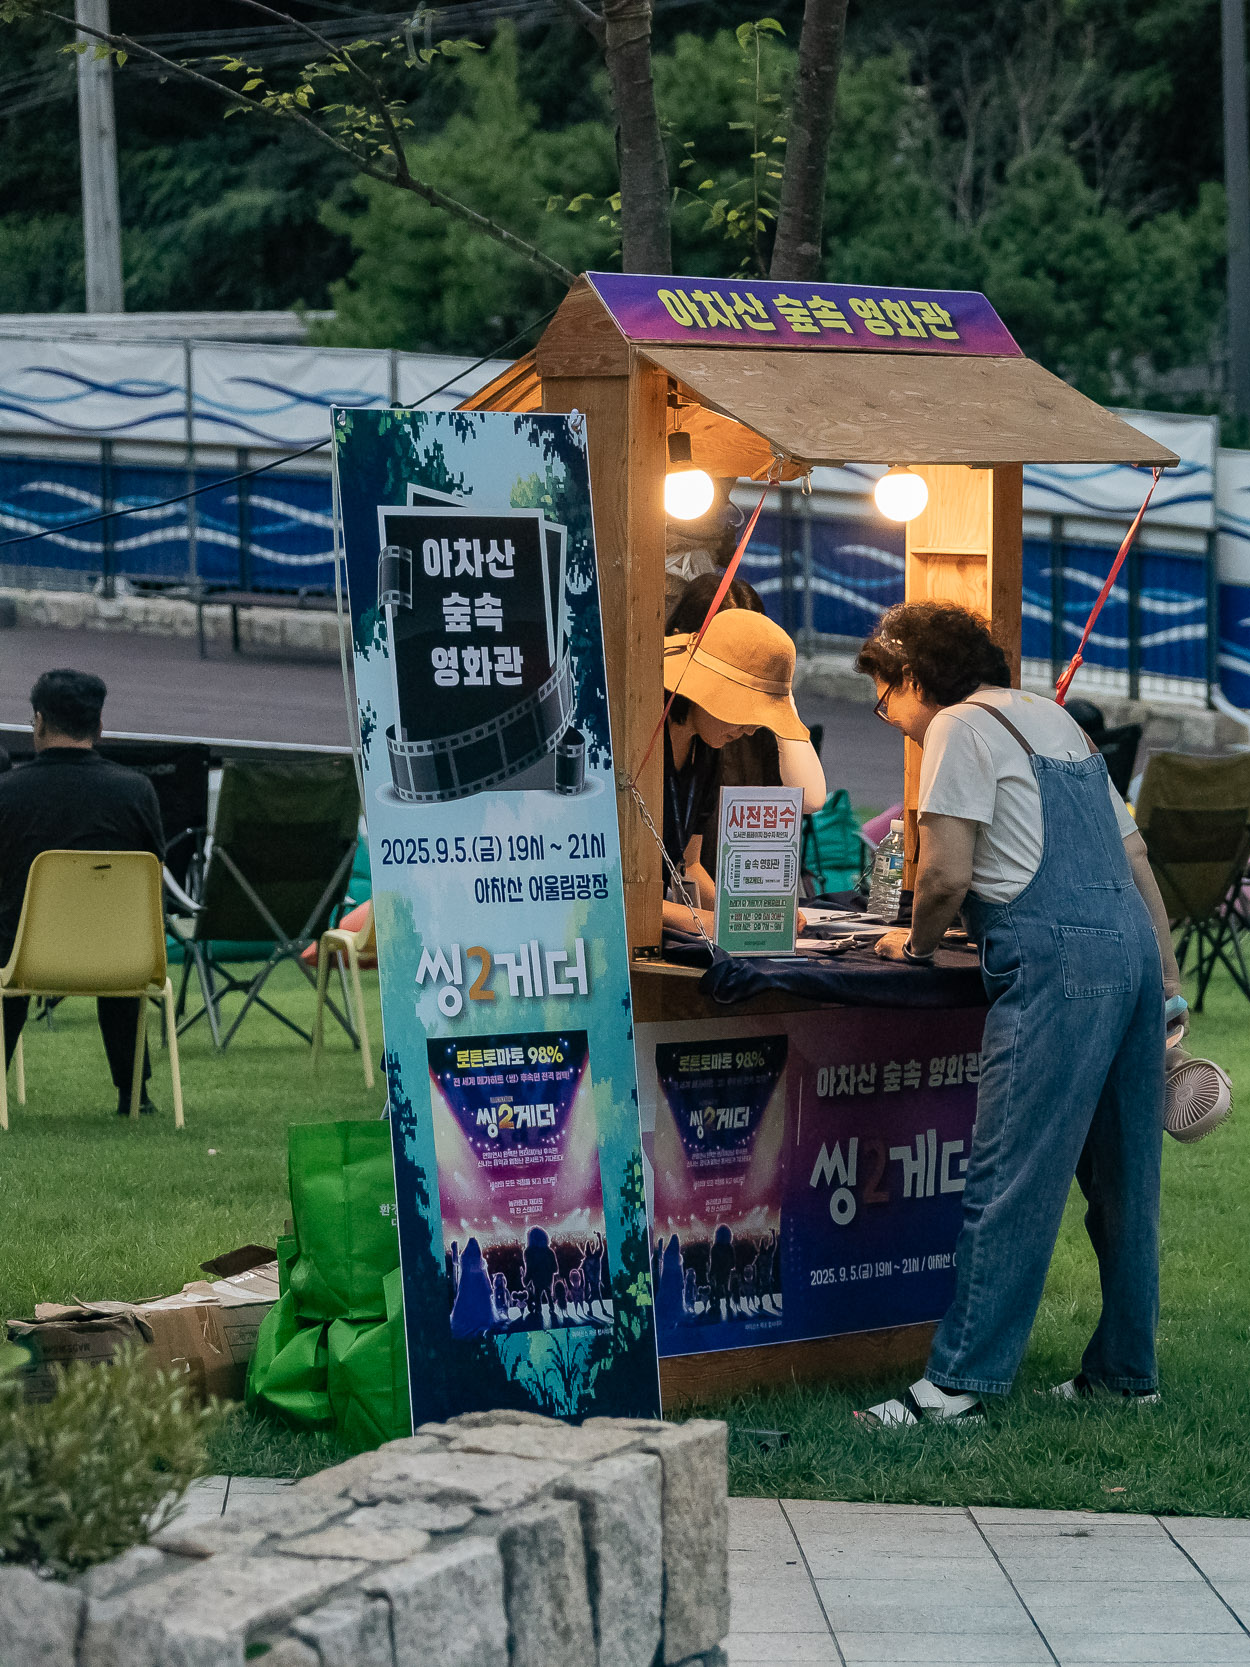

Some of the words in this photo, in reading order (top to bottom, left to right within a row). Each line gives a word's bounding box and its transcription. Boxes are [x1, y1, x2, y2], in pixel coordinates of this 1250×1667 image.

[657, 288, 775, 331] 아차산
[773, 294, 854, 334] 숲속
[849, 297, 960, 340] 영화관
[421, 537, 516, 579] 아차산
[442, 592, 503, 632] 숲속
[431, 646, 523, 687] 영화관
[728, 805, 795, 829] 사전접수
[381, 835, 502, 865] 2025.9.5.(금)
[507, 834, 545, 862] 19시
[568, 832, 606, 859] 21시
[760, 858, 779, 870] 영화관
[474, 876, 523, 904] 아차산
[529, 873, 609, 901] 어울림광장
[414, 937, 590, 1017] 씽2게더
[457, 1047, 525, 1068] 로튼토마토
[528, 1045, 564, 1065] 98%
[678, 1051, 733, 1073] 로튼토마토
[735, 1049, 765, 1070] 98%
[462, 1077, 476, 1086] 세계
[477, 1075, 504, 1085] 메가히트
[521, 1072, 541, 1082] 후속편
[541, 1071, 555, 1081] 전격
[816, 1062, 877, 1097] 아차산
[883, 1059, 922, 1093] 숲속
[476, 1103, 555, 1138] 씽2게더
[690, 1105, 749, 1140] 씽2게더
[810, 1268, 838, 1286] 2025.
[875, 1261, 892, 1277] 19시
[902, 1257, 919, 1274] 21시
[927, 1253, 950, 1270] 아차산
